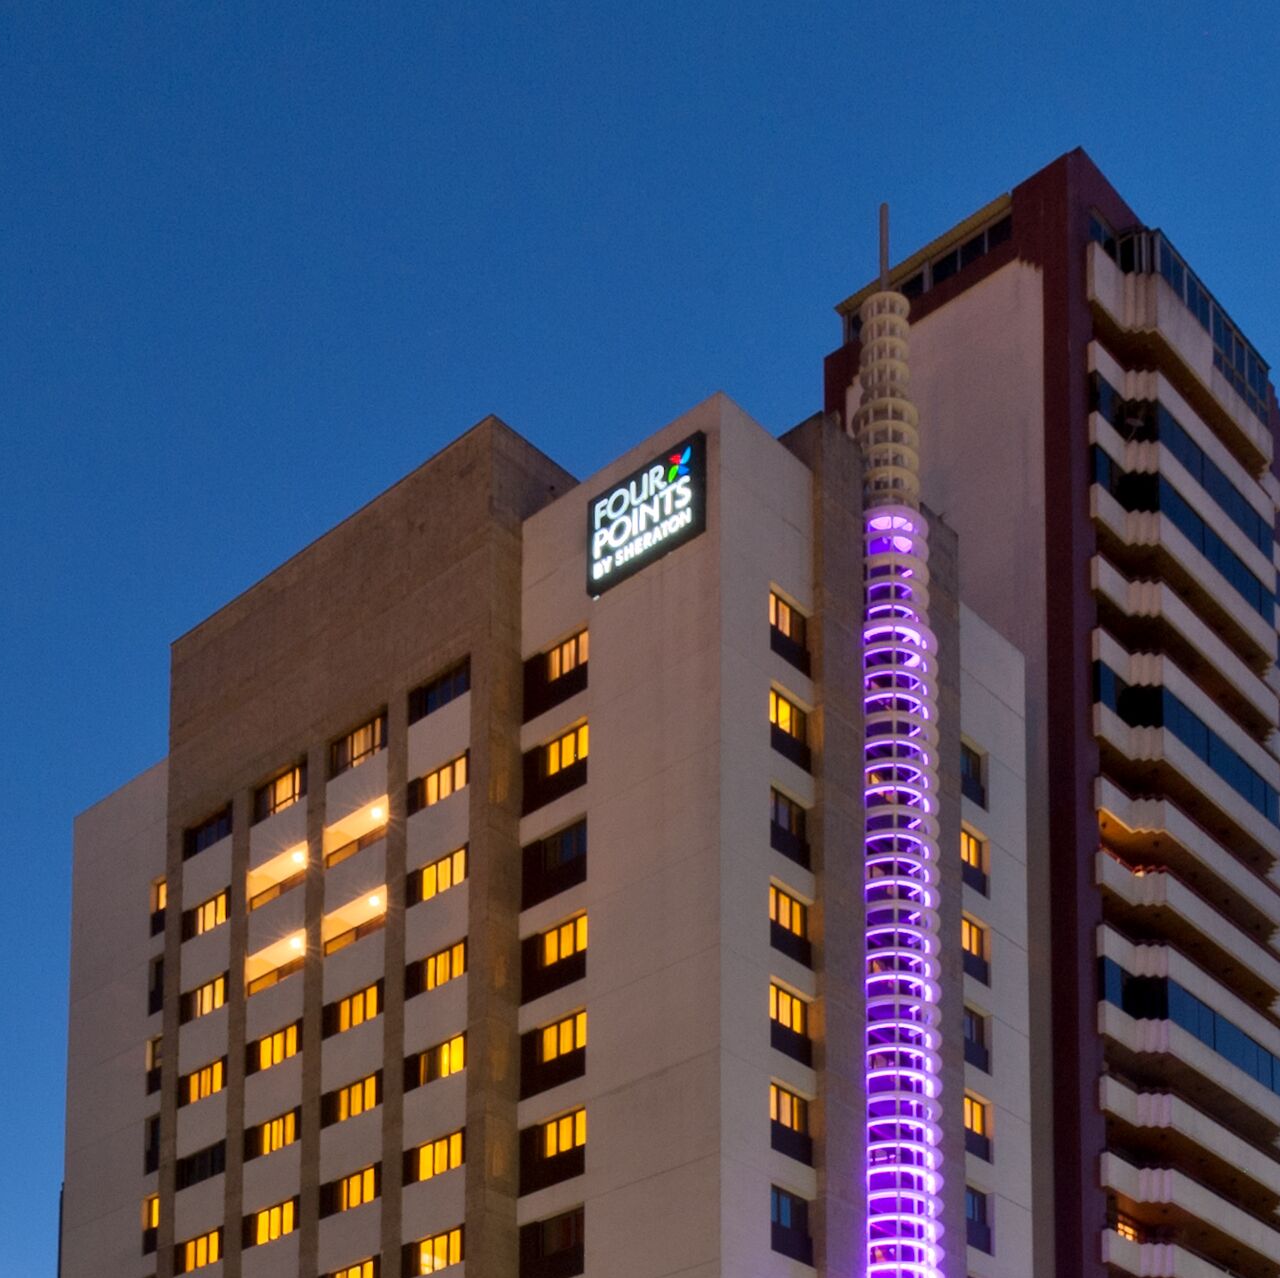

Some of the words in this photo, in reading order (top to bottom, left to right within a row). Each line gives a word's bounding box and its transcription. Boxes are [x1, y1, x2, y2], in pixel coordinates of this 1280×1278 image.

[593, 475, 692, 559] POINTS
[594, 464, 667, 530] FOUR
[592, 555, 612, 580] BY
[615, 507, 692, 567] SHERATON
